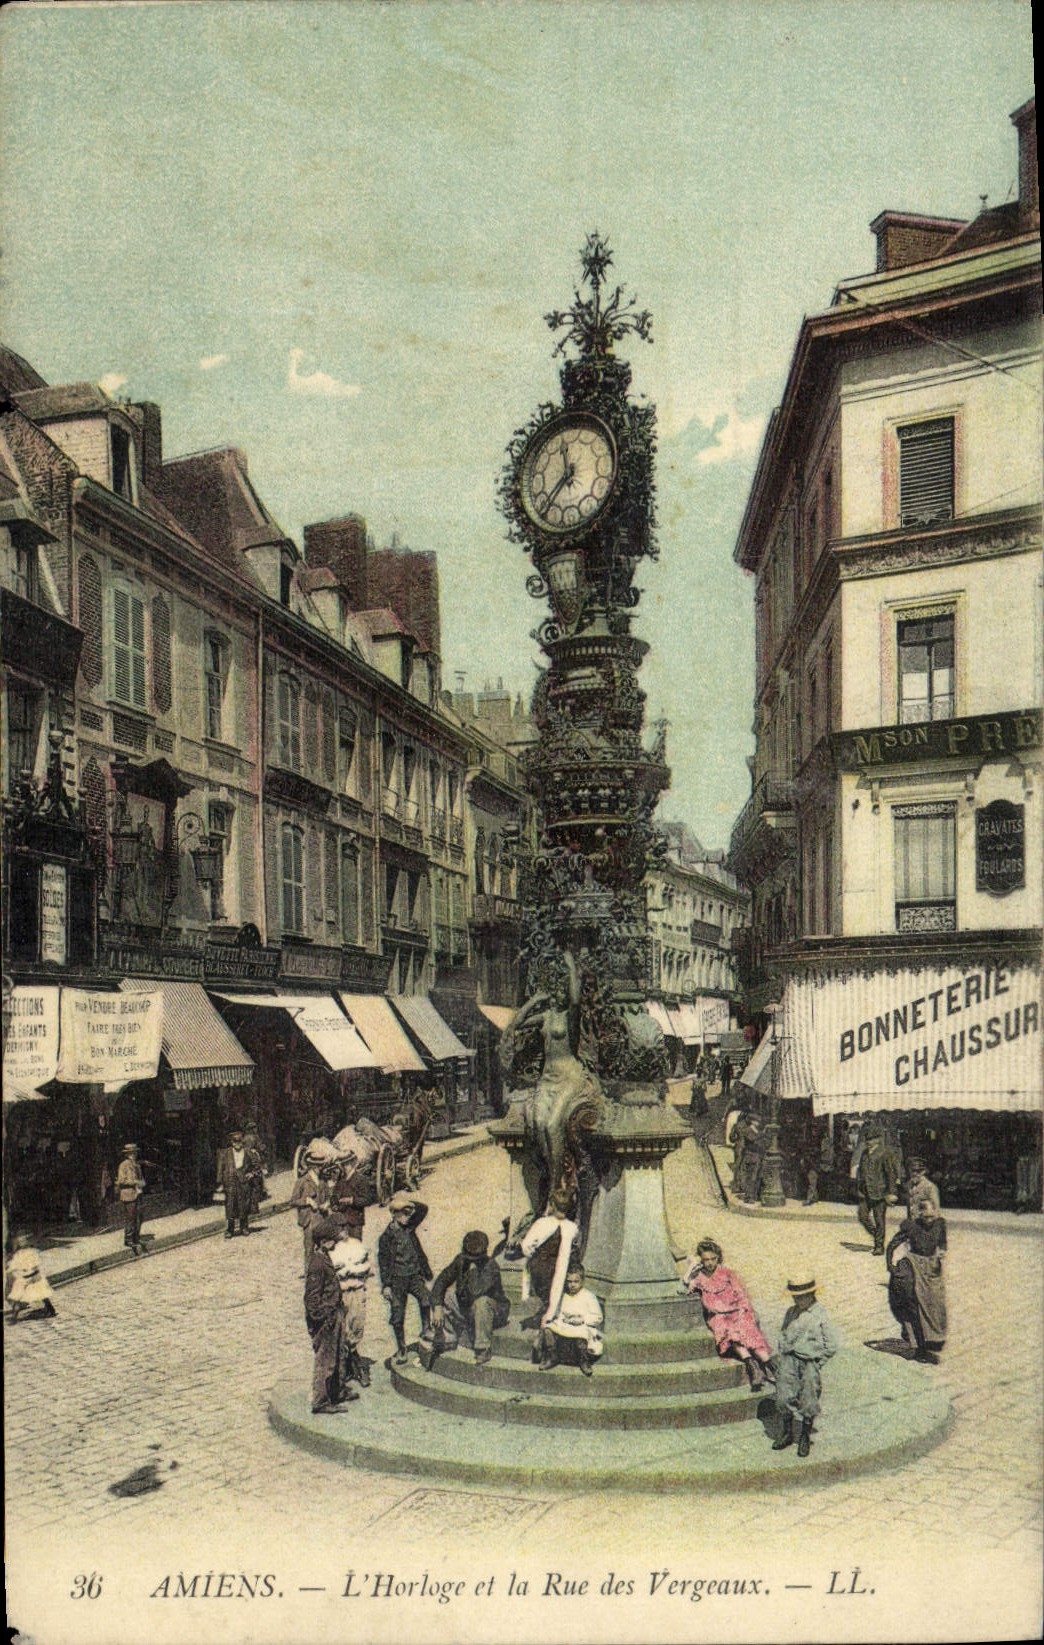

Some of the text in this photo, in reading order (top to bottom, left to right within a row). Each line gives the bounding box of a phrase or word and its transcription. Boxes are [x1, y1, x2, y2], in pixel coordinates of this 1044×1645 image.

[979, 819, 1024, 836] CRAVATES
[980, 858, 1024, 875] FOULARDS
[840, 963, 1010, 1062] BONNETERIE
